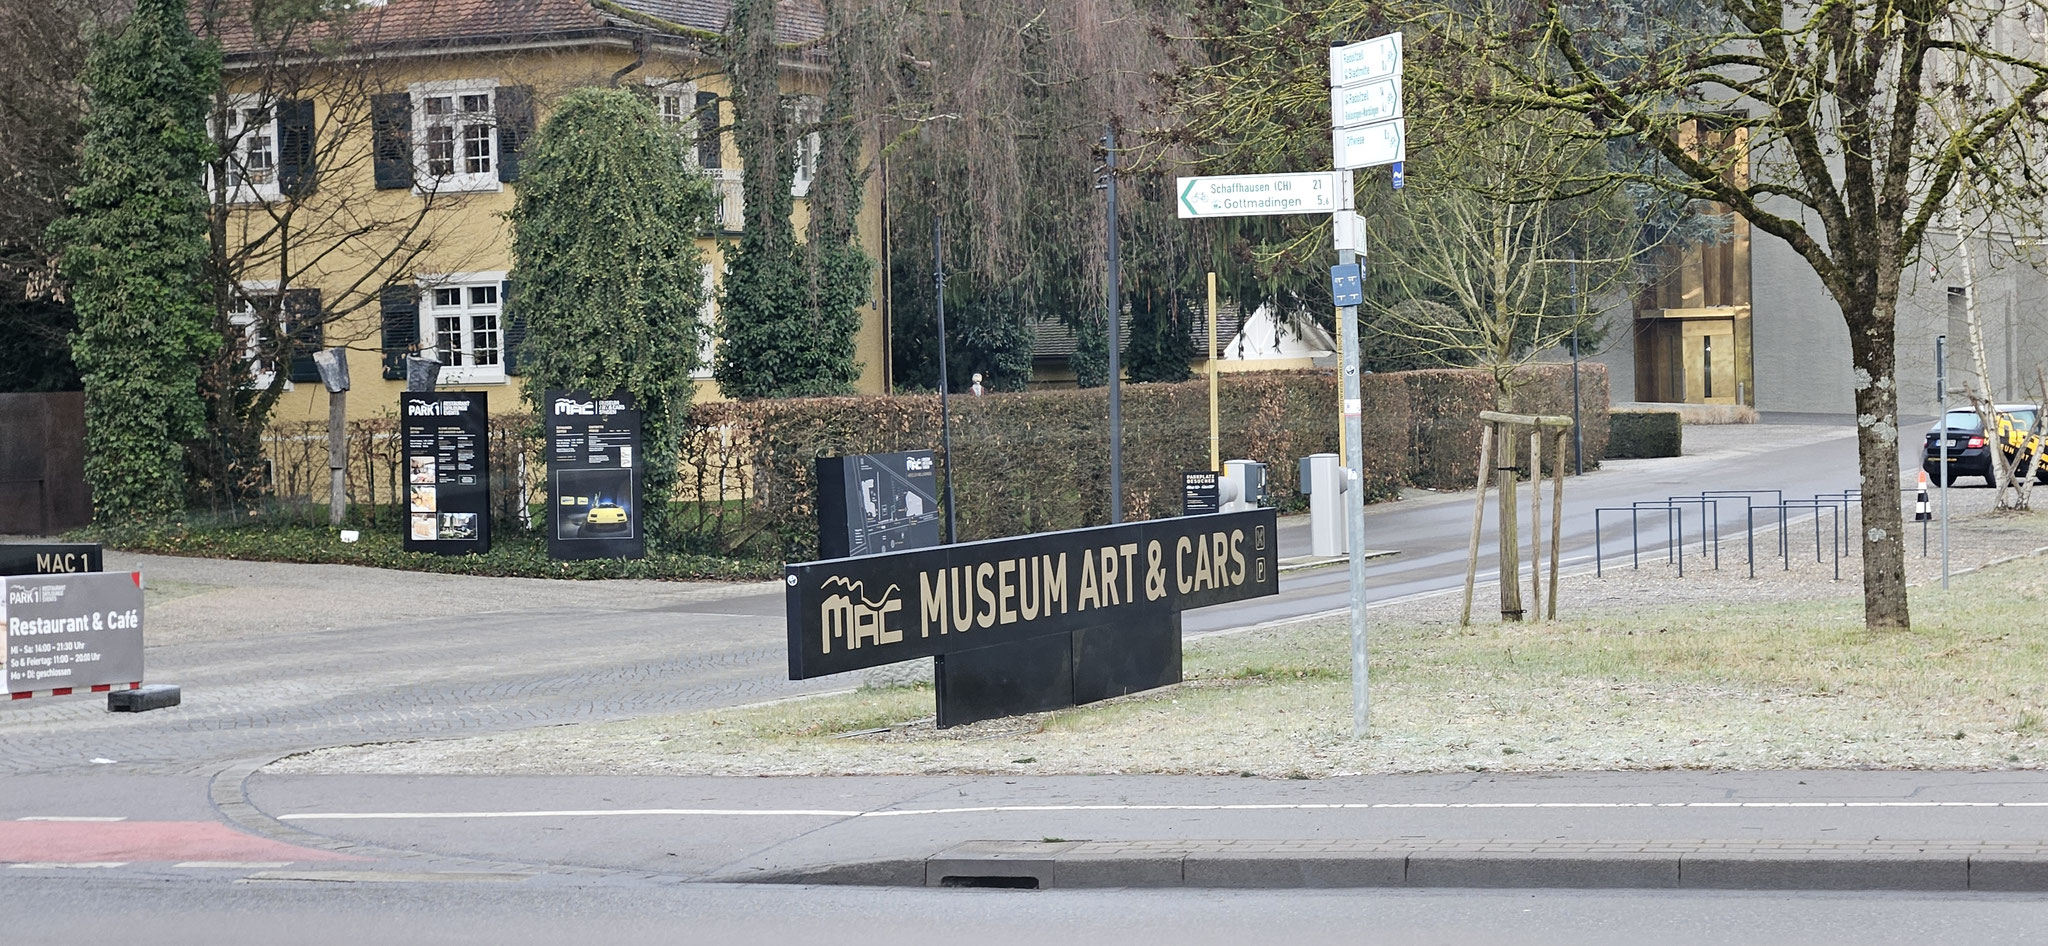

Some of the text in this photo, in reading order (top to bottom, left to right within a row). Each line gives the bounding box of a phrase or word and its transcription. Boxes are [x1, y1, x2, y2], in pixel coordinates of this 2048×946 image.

[1211, 180, 1292, 194] Schaffhausen (CH)
[1312, 179, 1322, 190] 21
[1224, 197, 1302, 209] Gottmadingen
[408, 405, 435, 416] PARK
[434, 404, 440, 416] 1
[555, 401, 594, 416] MAC
[36, 553, 89, 573] MAC 1
[821, 528, 1246, 654] MAC MUSEUM ART & CARS
[9, 591, 34, 604] PARK
[34, 591, 39, 603] 1
[9, 609, 138, 637] Restaurant & Café
[74, 641, 86, 650] Uhr
[53, 655, 69, 664] 11:00
[91, 653, 101, 661] Uhr
[10, 671, 21, 680] Mo
[36, 668, 72, 680] geschlossen
